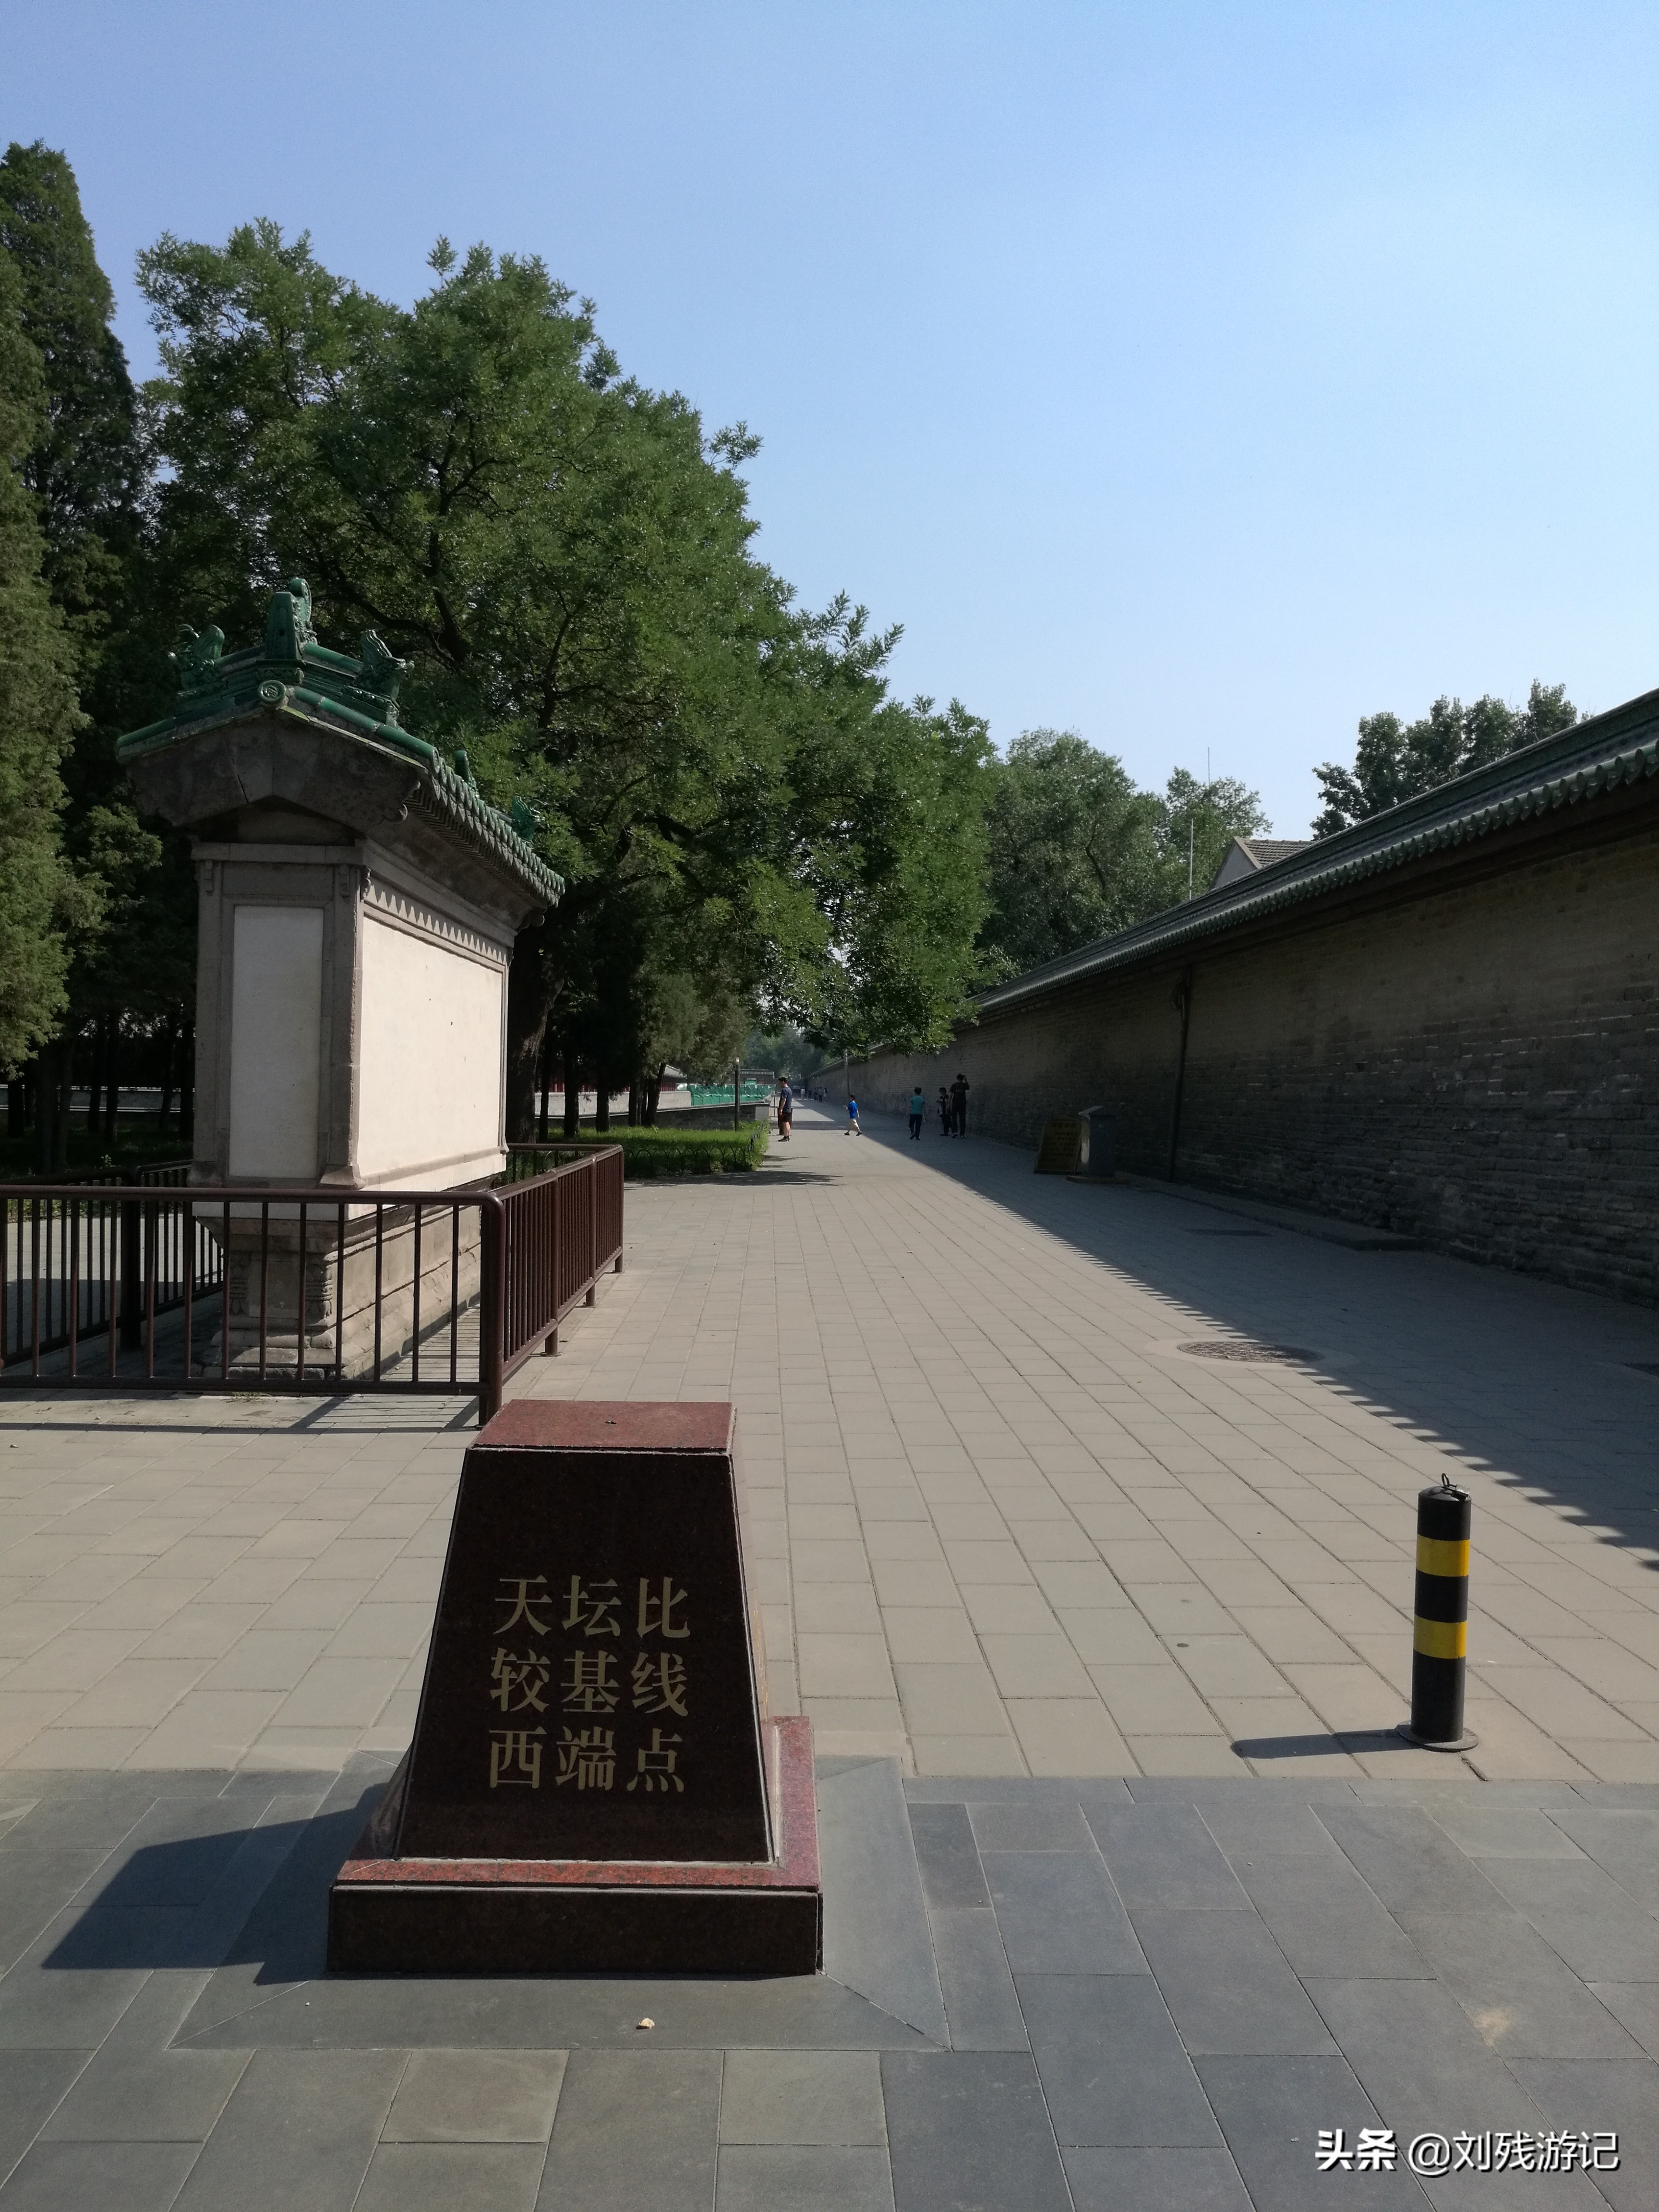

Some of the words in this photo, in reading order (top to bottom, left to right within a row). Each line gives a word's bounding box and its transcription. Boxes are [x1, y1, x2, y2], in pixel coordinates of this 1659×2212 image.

[493, 1575, 691, 1638] 天坛比
[490, 1647, 688, 1717] 较基线
[489, 1726, 685, 1792] 西端点
